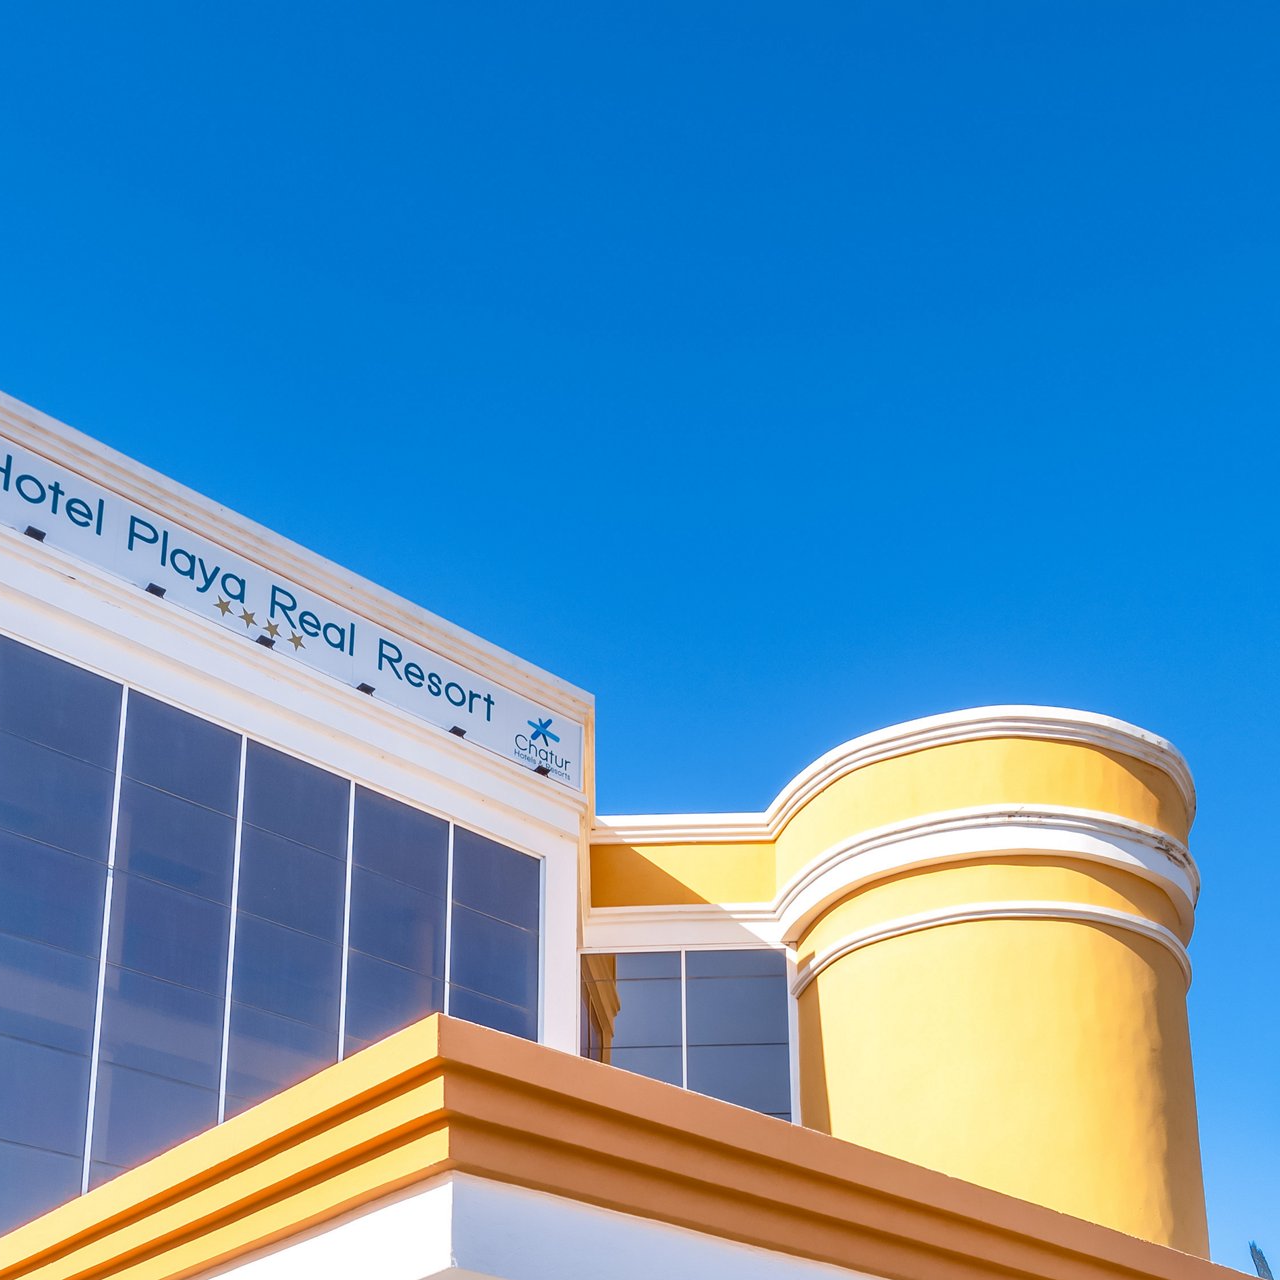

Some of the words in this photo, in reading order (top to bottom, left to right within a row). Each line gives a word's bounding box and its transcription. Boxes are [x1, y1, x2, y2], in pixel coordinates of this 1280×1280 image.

[127, 515, 247, 604] Playa
[269, 584, 357, 658] Real
[377, 637, 495, 722] Resort
[513, 748, 537, 765] Hotels
[514, 734, 572, 771] Chatur
